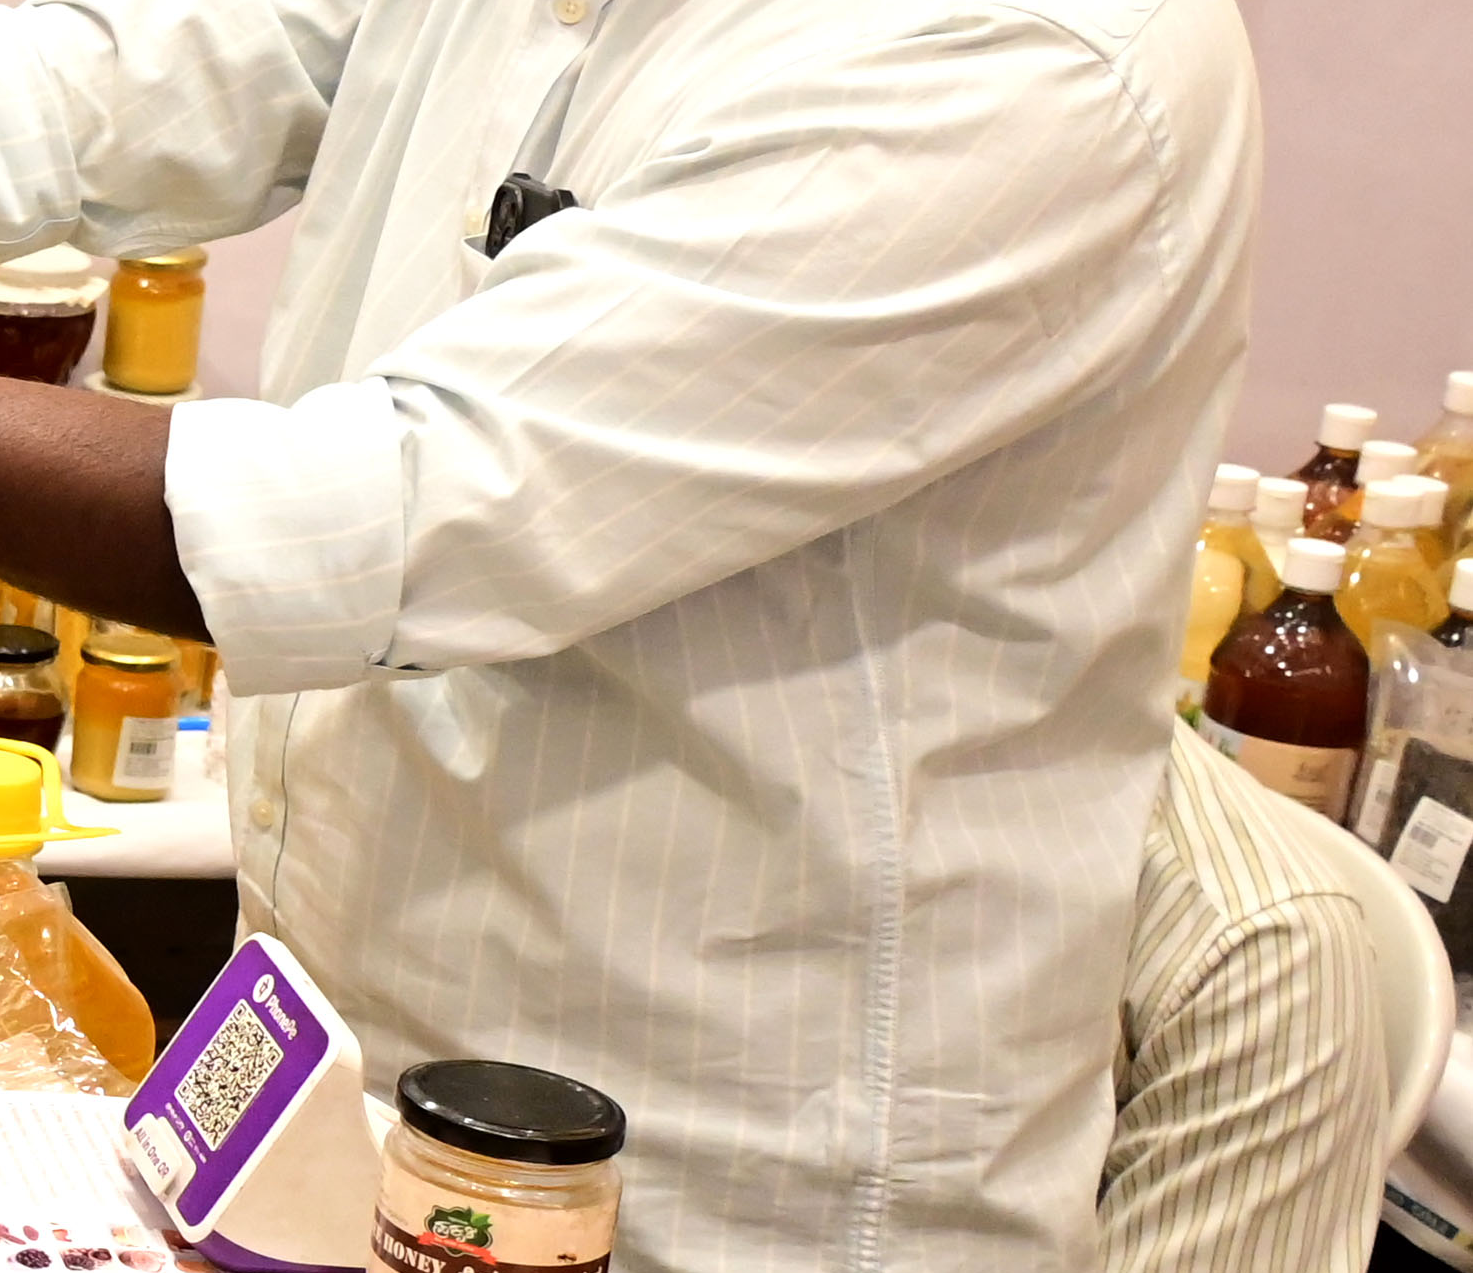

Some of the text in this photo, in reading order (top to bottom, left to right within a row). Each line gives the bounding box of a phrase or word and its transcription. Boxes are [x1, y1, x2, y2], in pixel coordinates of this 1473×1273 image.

[264, 994, 299, 1041] PhonePe
[133, 1127, 146, 1145] All
[147, 1146, 162, 1167] One
